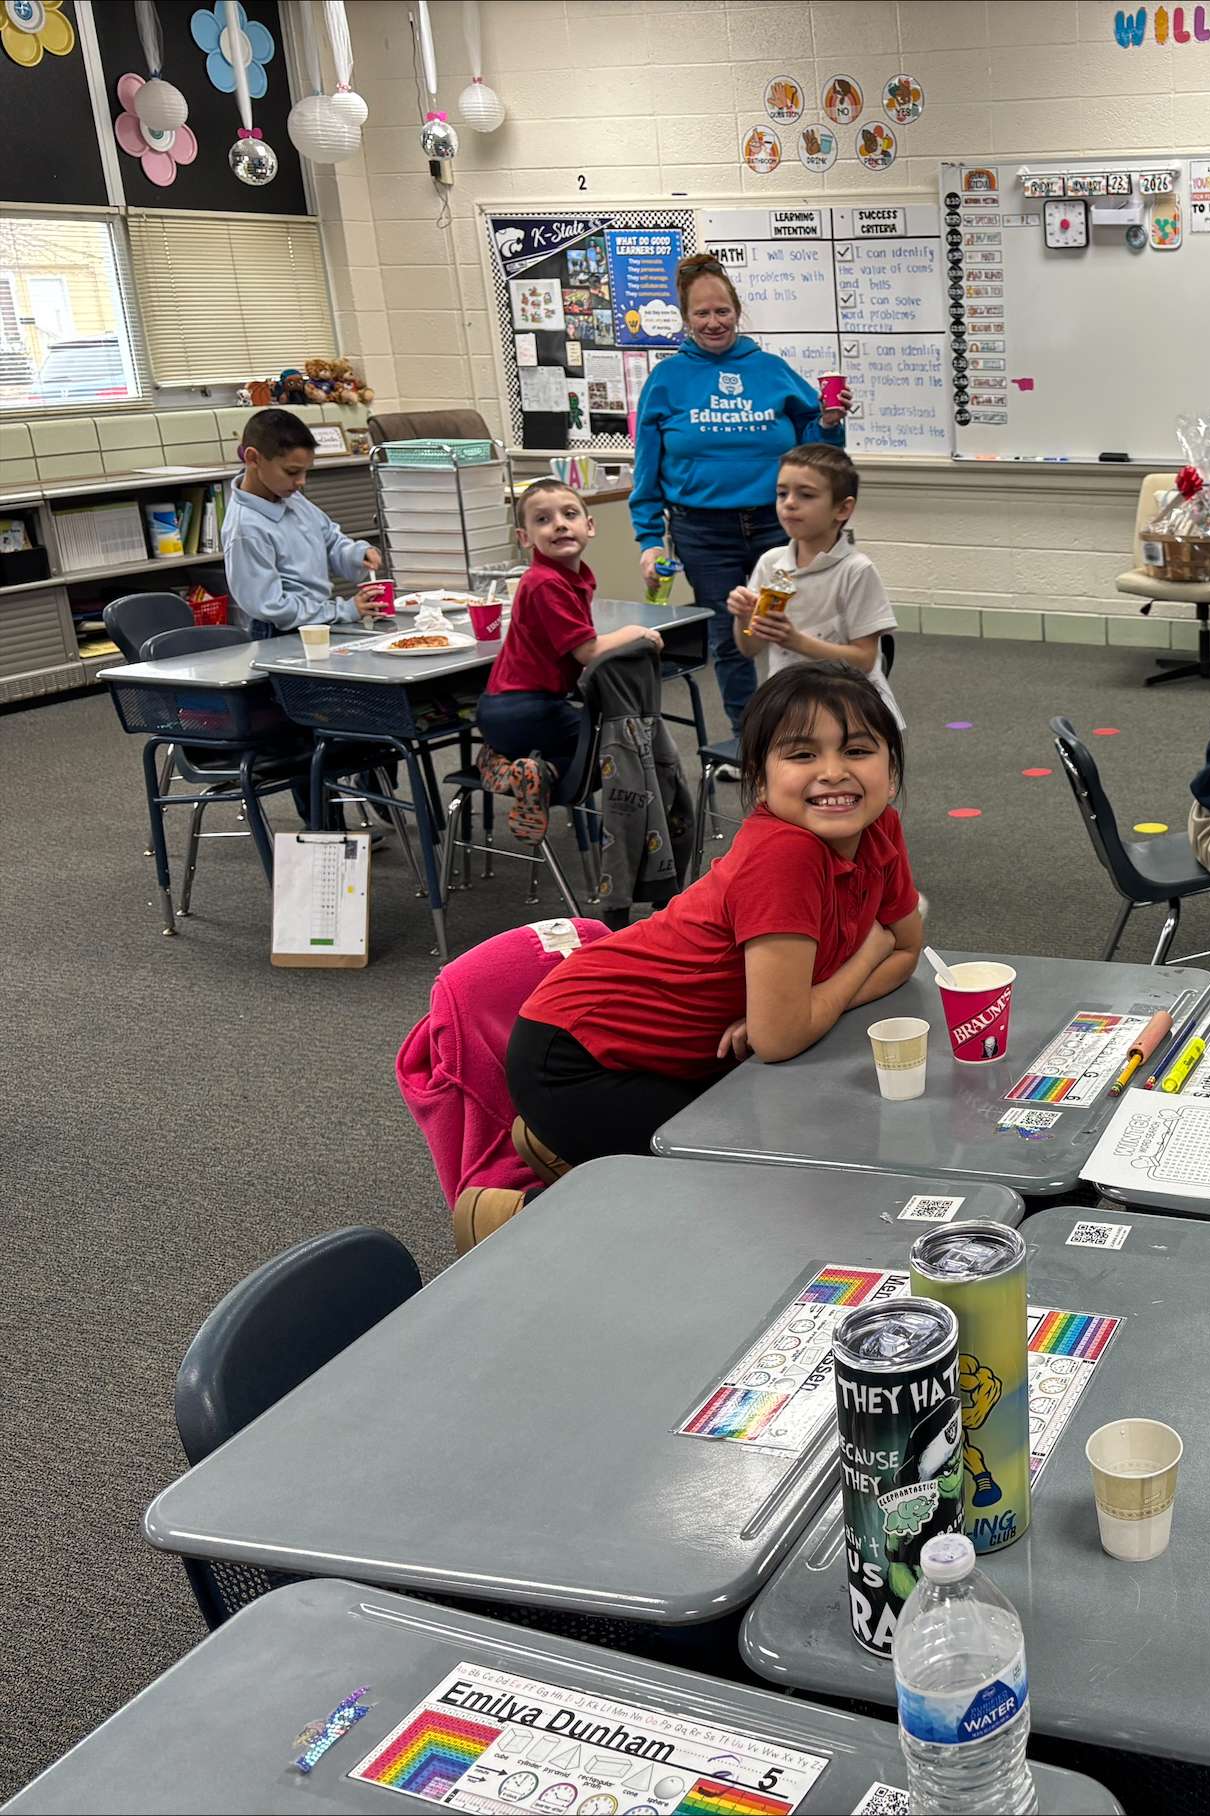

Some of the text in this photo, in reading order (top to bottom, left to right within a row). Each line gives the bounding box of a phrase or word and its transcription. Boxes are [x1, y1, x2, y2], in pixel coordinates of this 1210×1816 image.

[837, 107, 850, 116] NO
[896, 108, 911, 117] YES
[577, 175, 587, 191] 2
[1143, 177, 1169, 192] 2026
[858, 210, 899, 220] SUCCESS
[1192, 203, 1206, 213] TO
[774, 212, 815, 223] LEARNING
[531, 220, 585, 248] K-State
[774, 225, 818, 236] INTENTION
[860, 223, 897, 234] CRITERIA
[615, 236, 671, 246] WHAT DO GOOD
[616, 246, 672, 256] LEARNERS DO?
[790, 248, 819, 261] solve
[867, 246, 935, 262] can identify
[750, 270, 825, 288] problems with
[747, 288, 798, 301] and bills
[871, 295, 922, 306] can solve
[841, 309, 916, 326] word problems
[710, 395, 753, 411] Early
[880, 404, 936, 418] understand
[690, 407, 775, 424] Education
[554, 456, 591, 489] YAY
[952, 986, 1012, 1044] BRAUM'S
[1112, 1114, 1152, 1157] WINTER
[837, 1378, 903, 1415] THEY
[842, 1464, 882, 1497] THEY
[989, 1525, 1017, 1547] CLUB
[847, 1548, 885, 1589] US
[441, 1680, 676, 1762] Emilya Dunham
[468, 1668, 809, 1766] Bb Cc Dd Ff Gg Hh Kk Ll Mm Nn Pp Qq Rr Ss Tt Vv Ww Xx Yy
[963, 1696, 1015, 1733] WATER
[494, 1752, 615, 1787] cube cylinder pyramid rectangular
[758, 1767, 785, 1790] 5
[583, 1781, 639, 1797] prism cone
[646, 1797, 670, 1808] sphere
